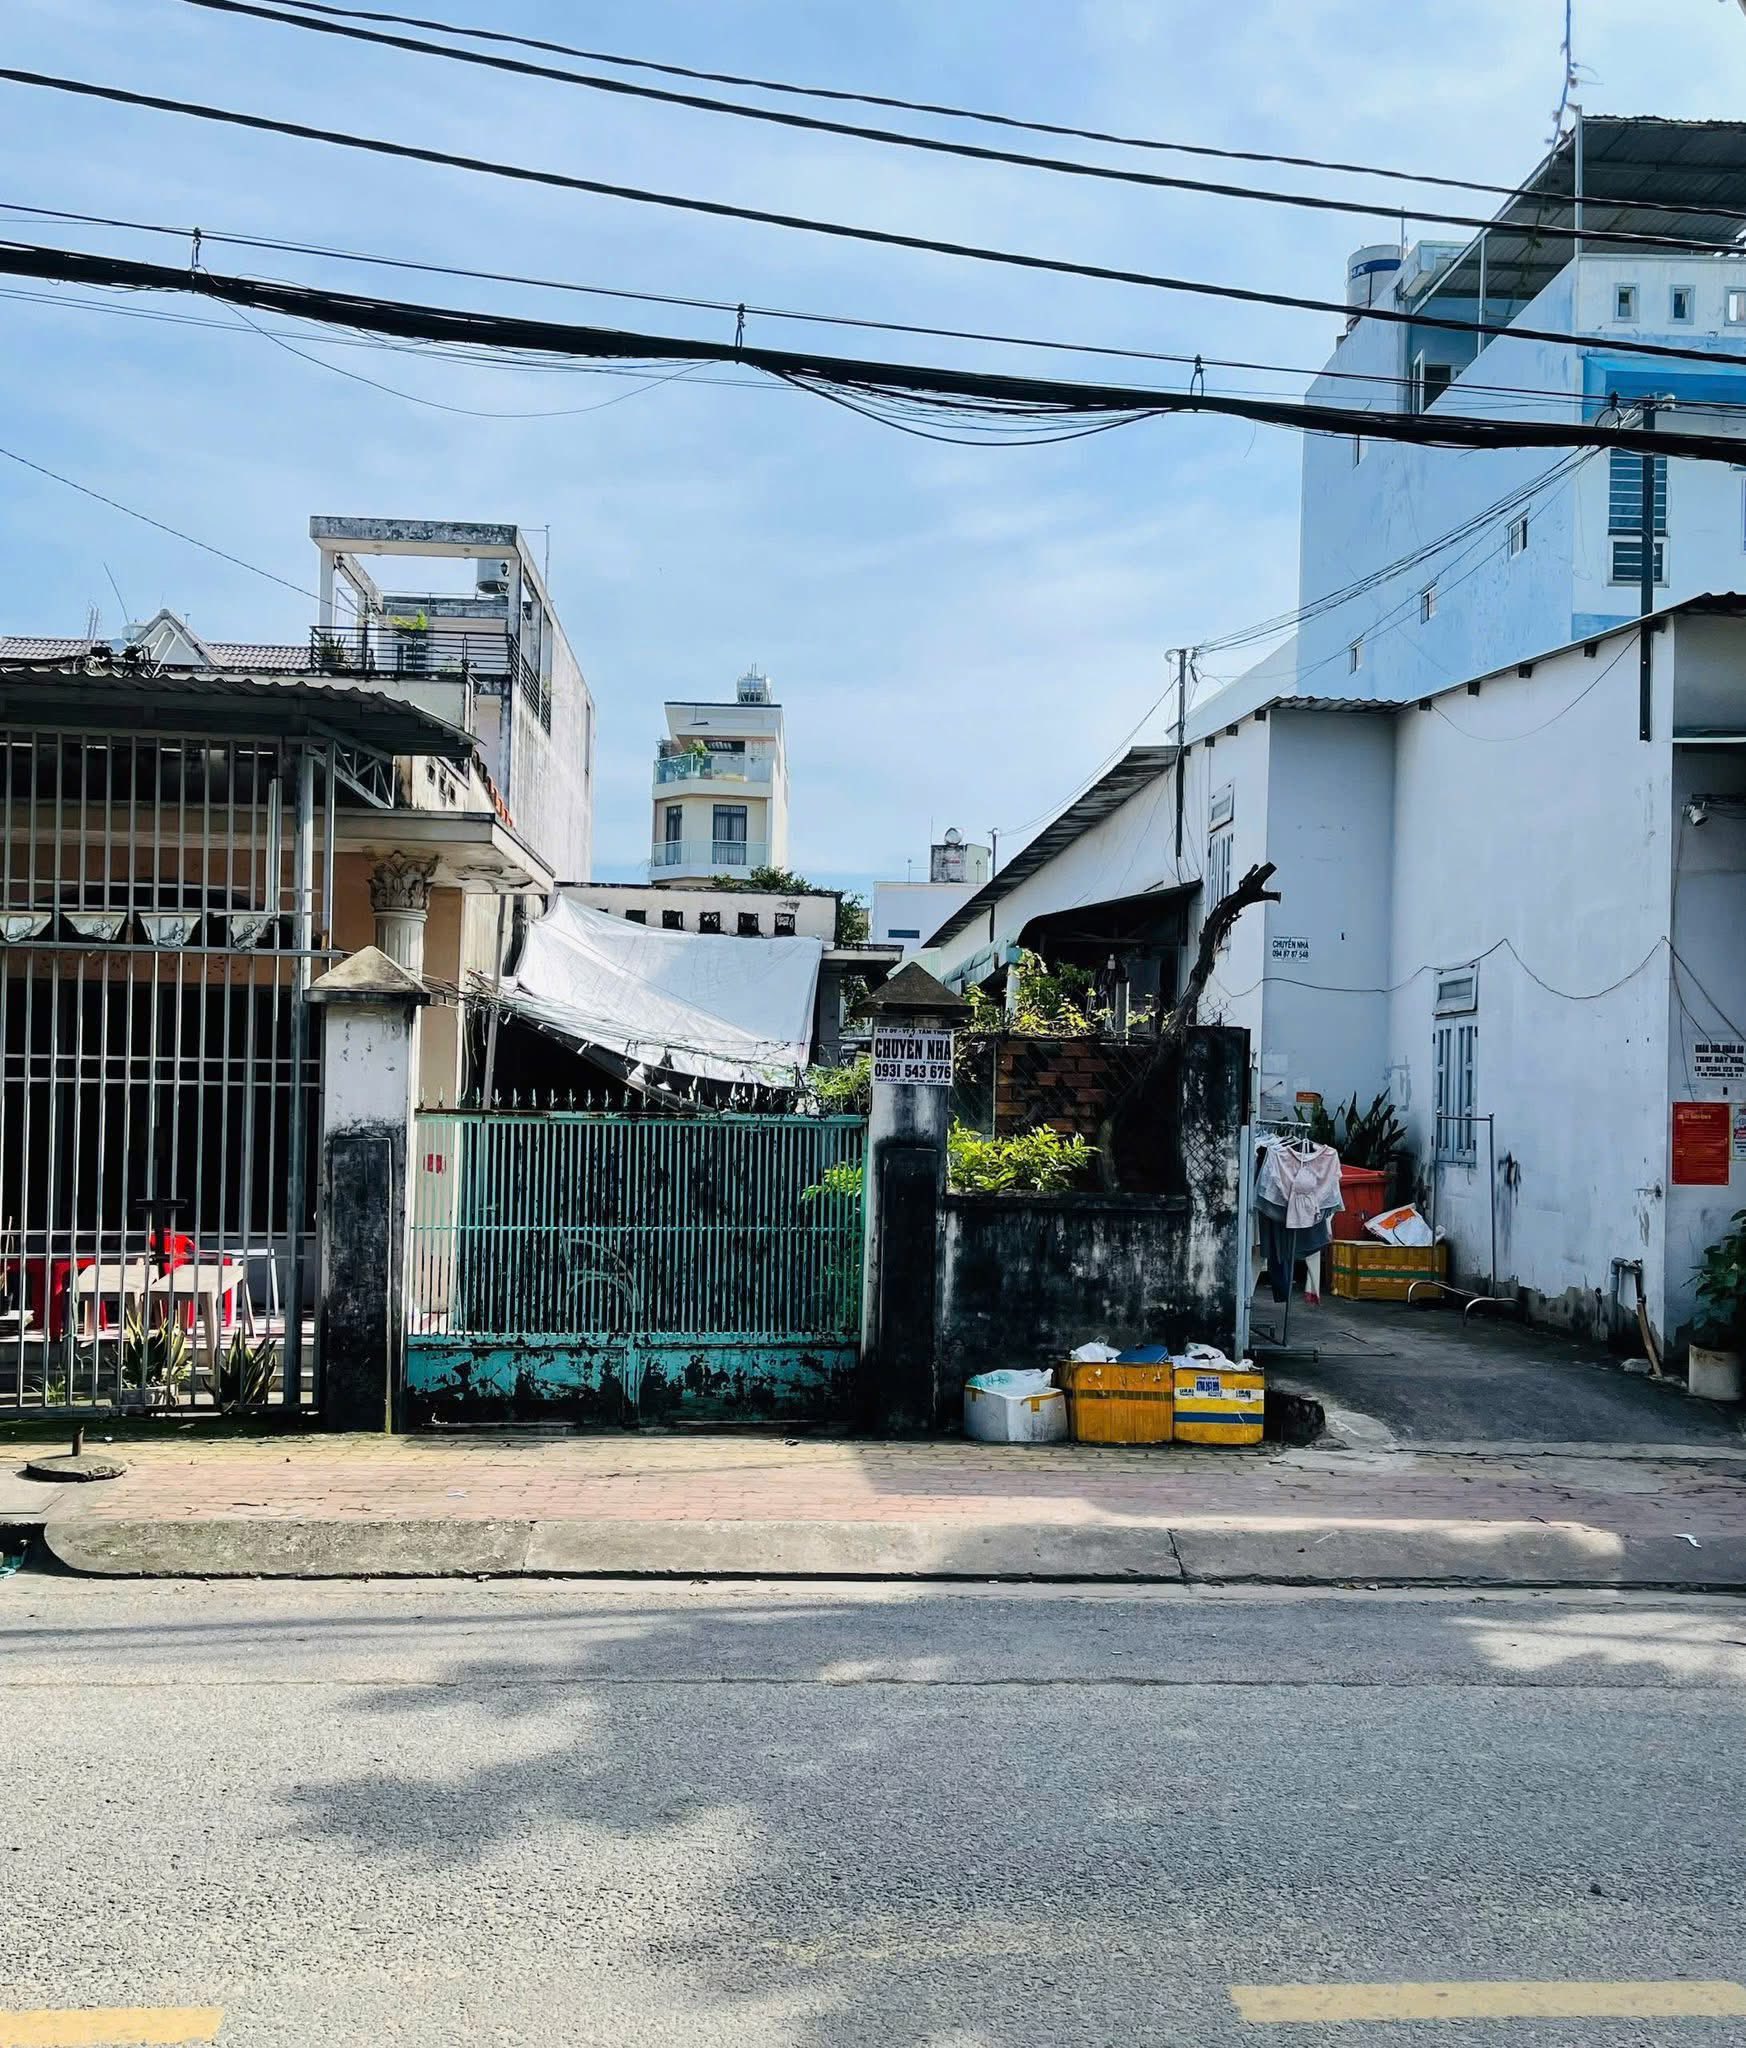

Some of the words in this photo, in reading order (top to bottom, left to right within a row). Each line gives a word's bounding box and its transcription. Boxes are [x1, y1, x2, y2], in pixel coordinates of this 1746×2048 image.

[875, 1030, 923, 1059] CHUYỂN
[926, 1035, 951, 1060] NHÀ
[875, 1063, 900, 1078] 0931
[904, 1064, 926, 1079] 543
[929, 1065, 951, 1079] 676
